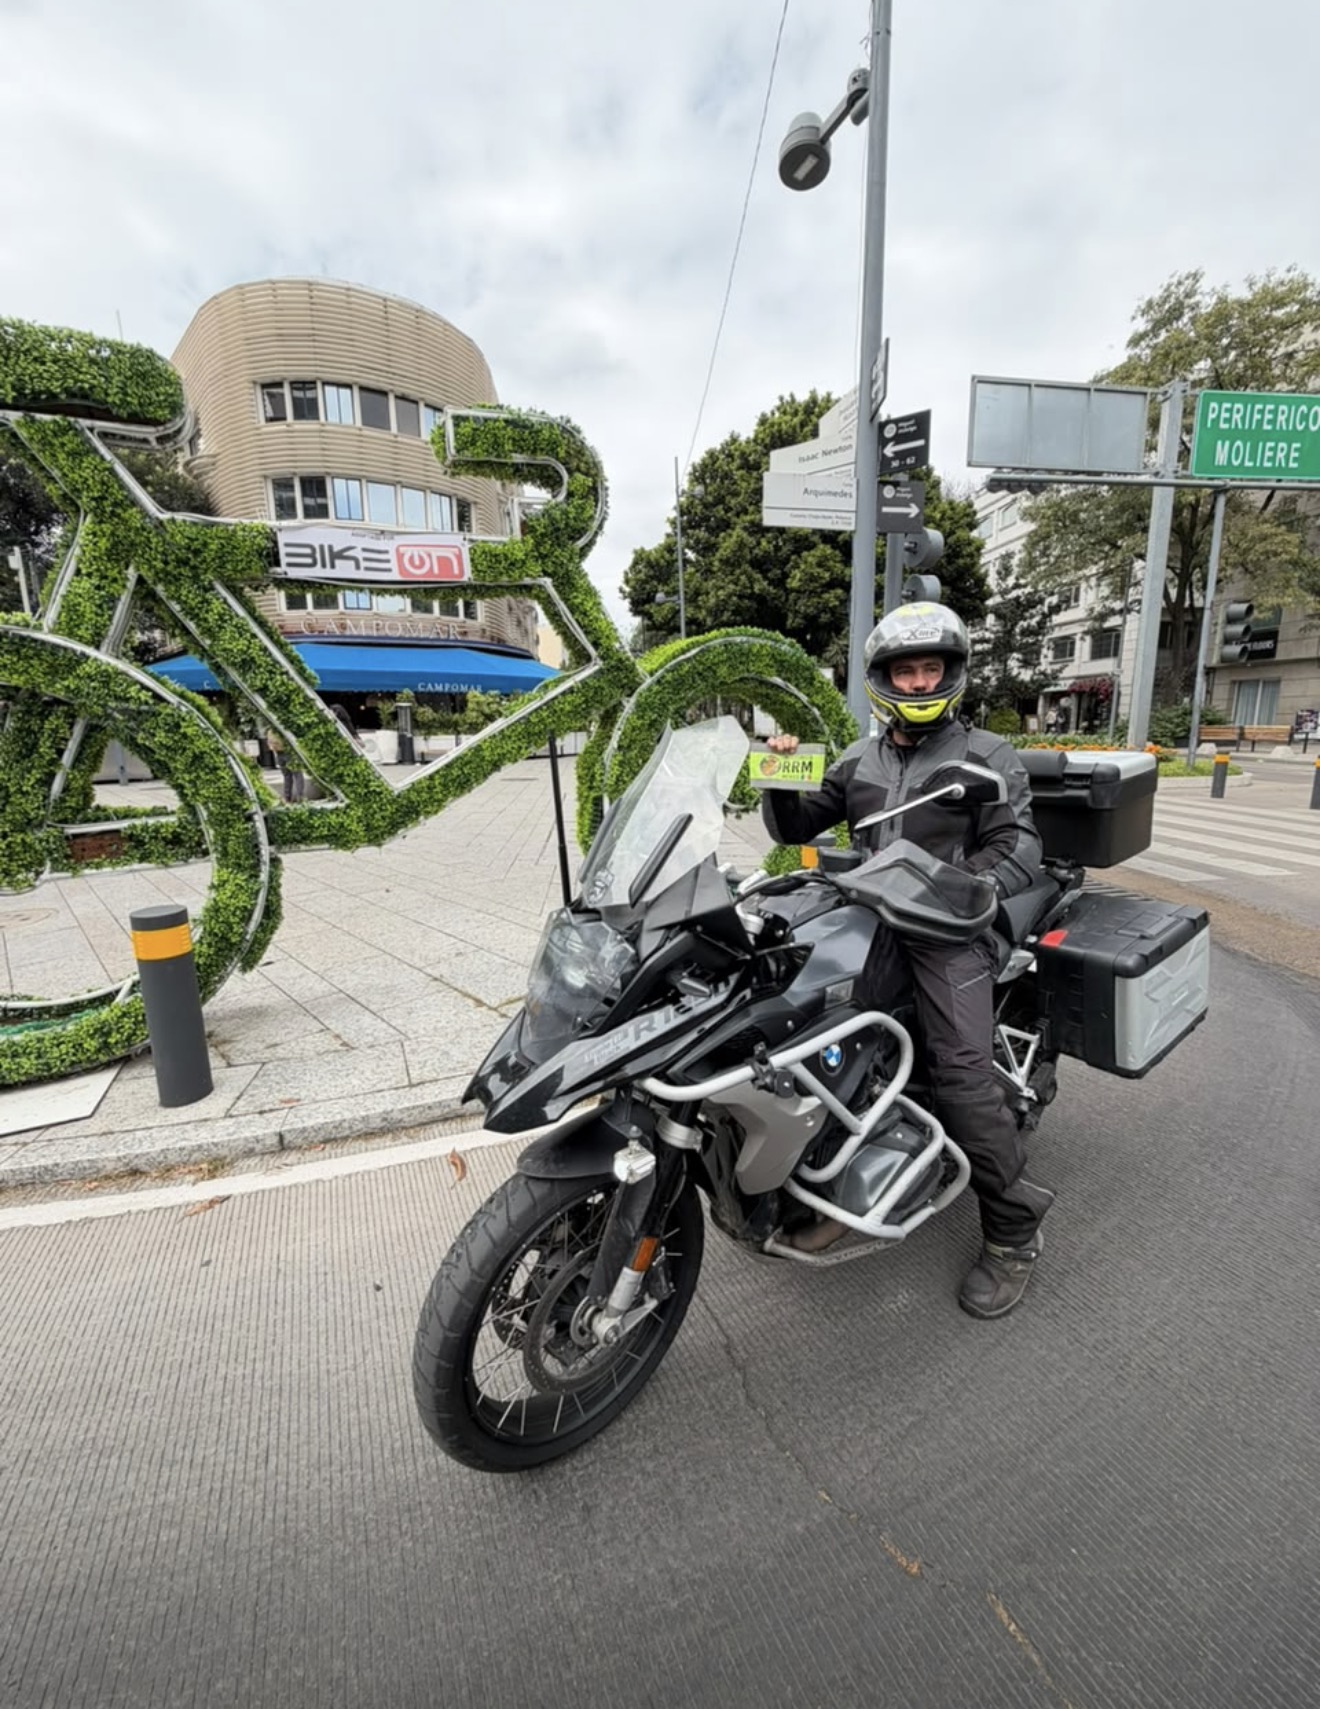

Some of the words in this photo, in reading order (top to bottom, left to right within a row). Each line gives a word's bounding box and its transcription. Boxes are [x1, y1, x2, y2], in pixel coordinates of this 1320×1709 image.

[1207, 402, 1320, 431] PERIFERICO
[798, 451, 820, 463] Isaac
[821, 443, 853, 457] Newton
[1214, 440, 1301, 469] MOLIERE
[803, 487, 853, 499] Arquimedes
[284, 542, 393, 573] BIKE
[301, 618, 460, 640] CAMPOMAR
[417, 682, 483, 693] CAMPOMAR
[782, 760, 813, 774] RRM
